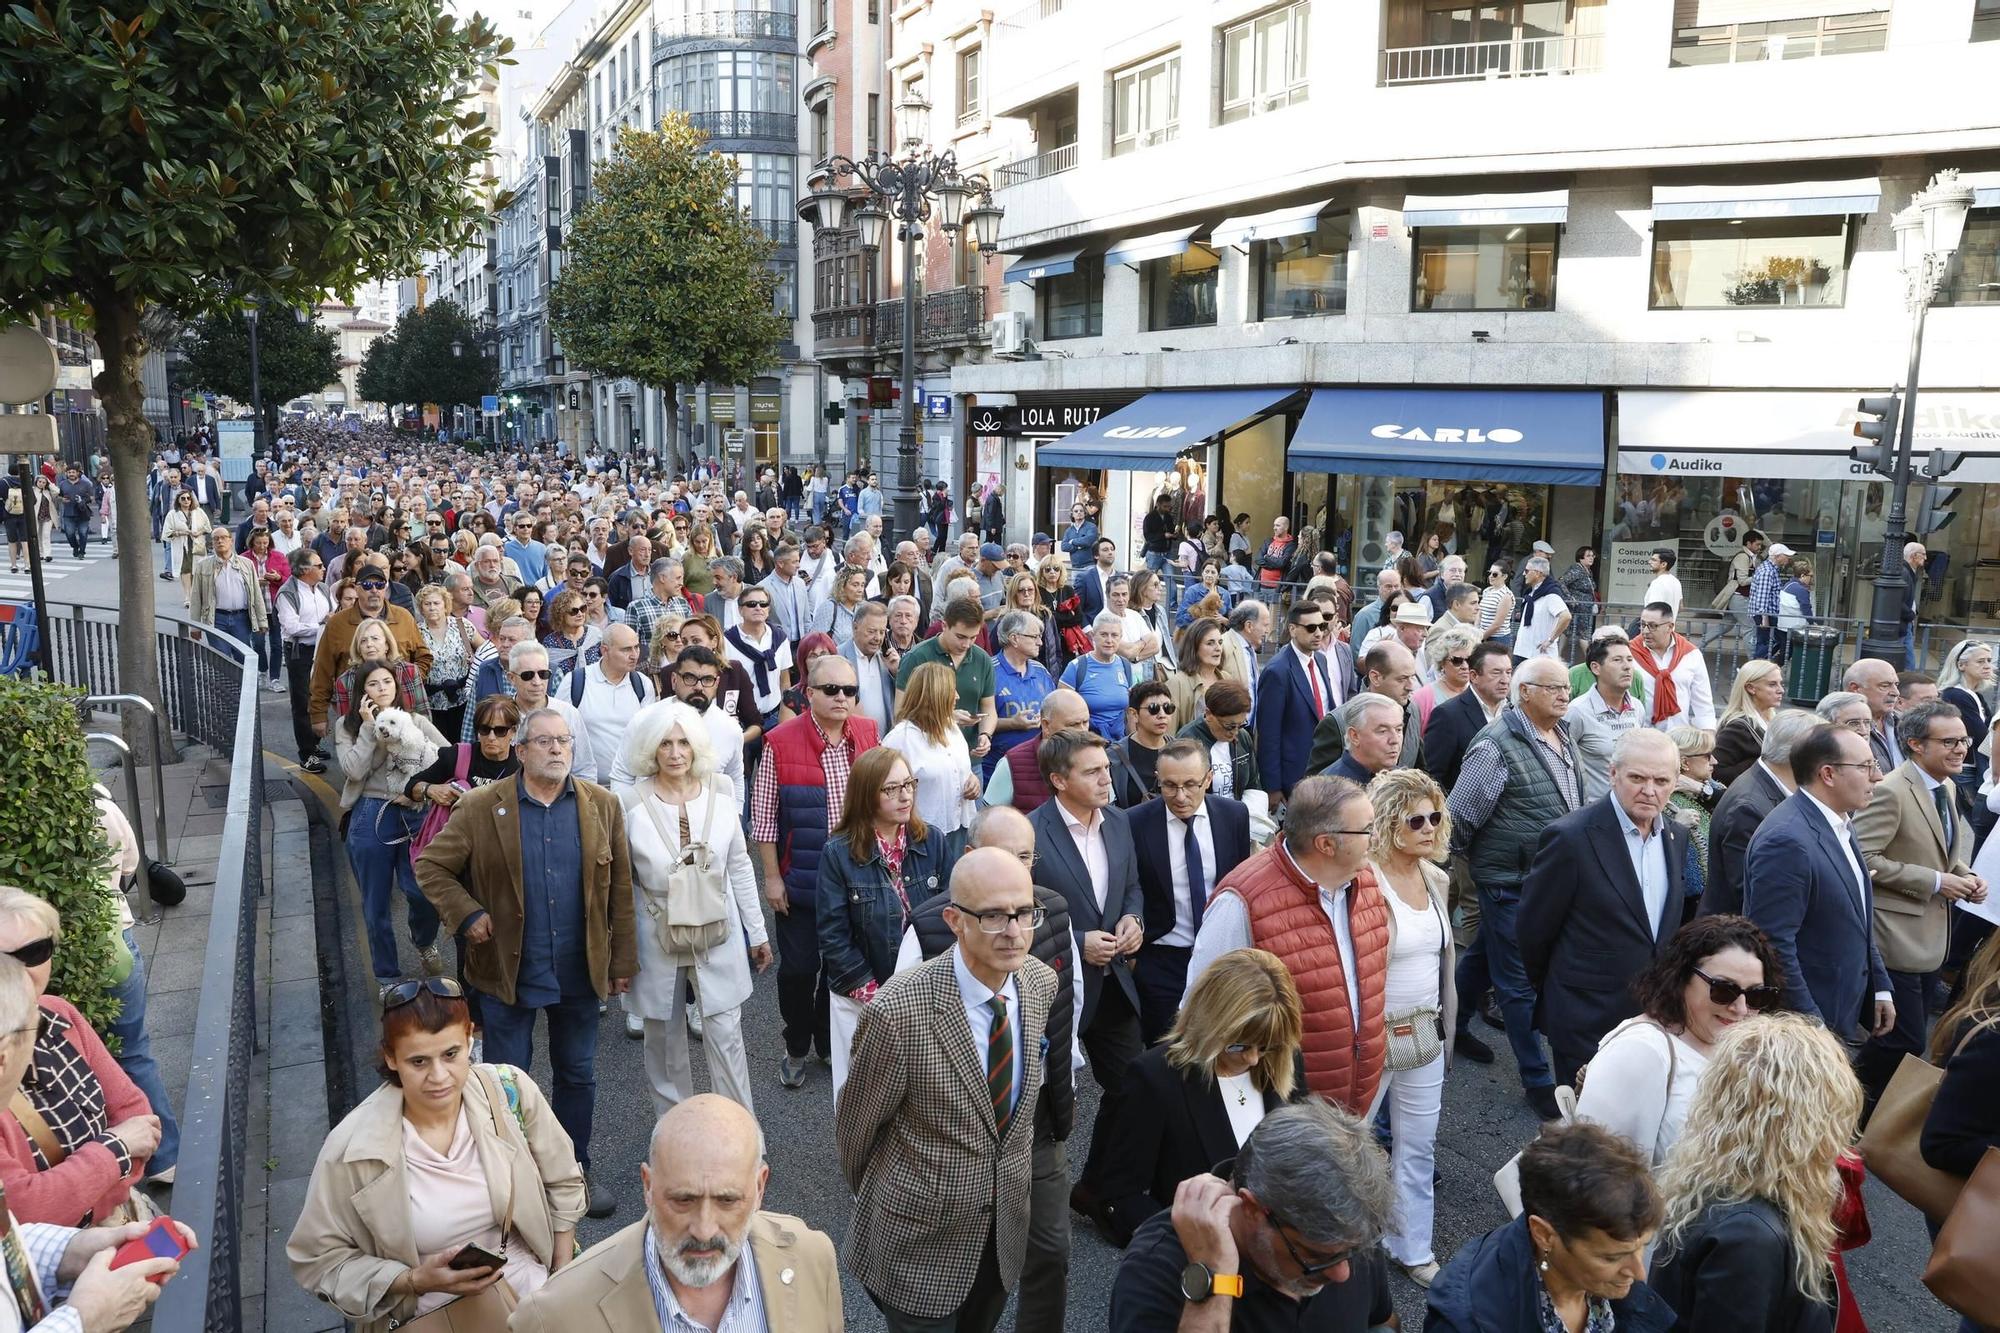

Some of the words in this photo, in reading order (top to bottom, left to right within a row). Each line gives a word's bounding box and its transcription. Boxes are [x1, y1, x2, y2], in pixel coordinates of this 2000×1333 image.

[1021, 408, 1055, 426] LOLA
[1064, 407, 1100, 425] RUIZ
[1370, 424, 1524, 444] CARLO
[1669, 458, 1723, 471] Audika
[1618, 547, 1652, 556] Conserv
